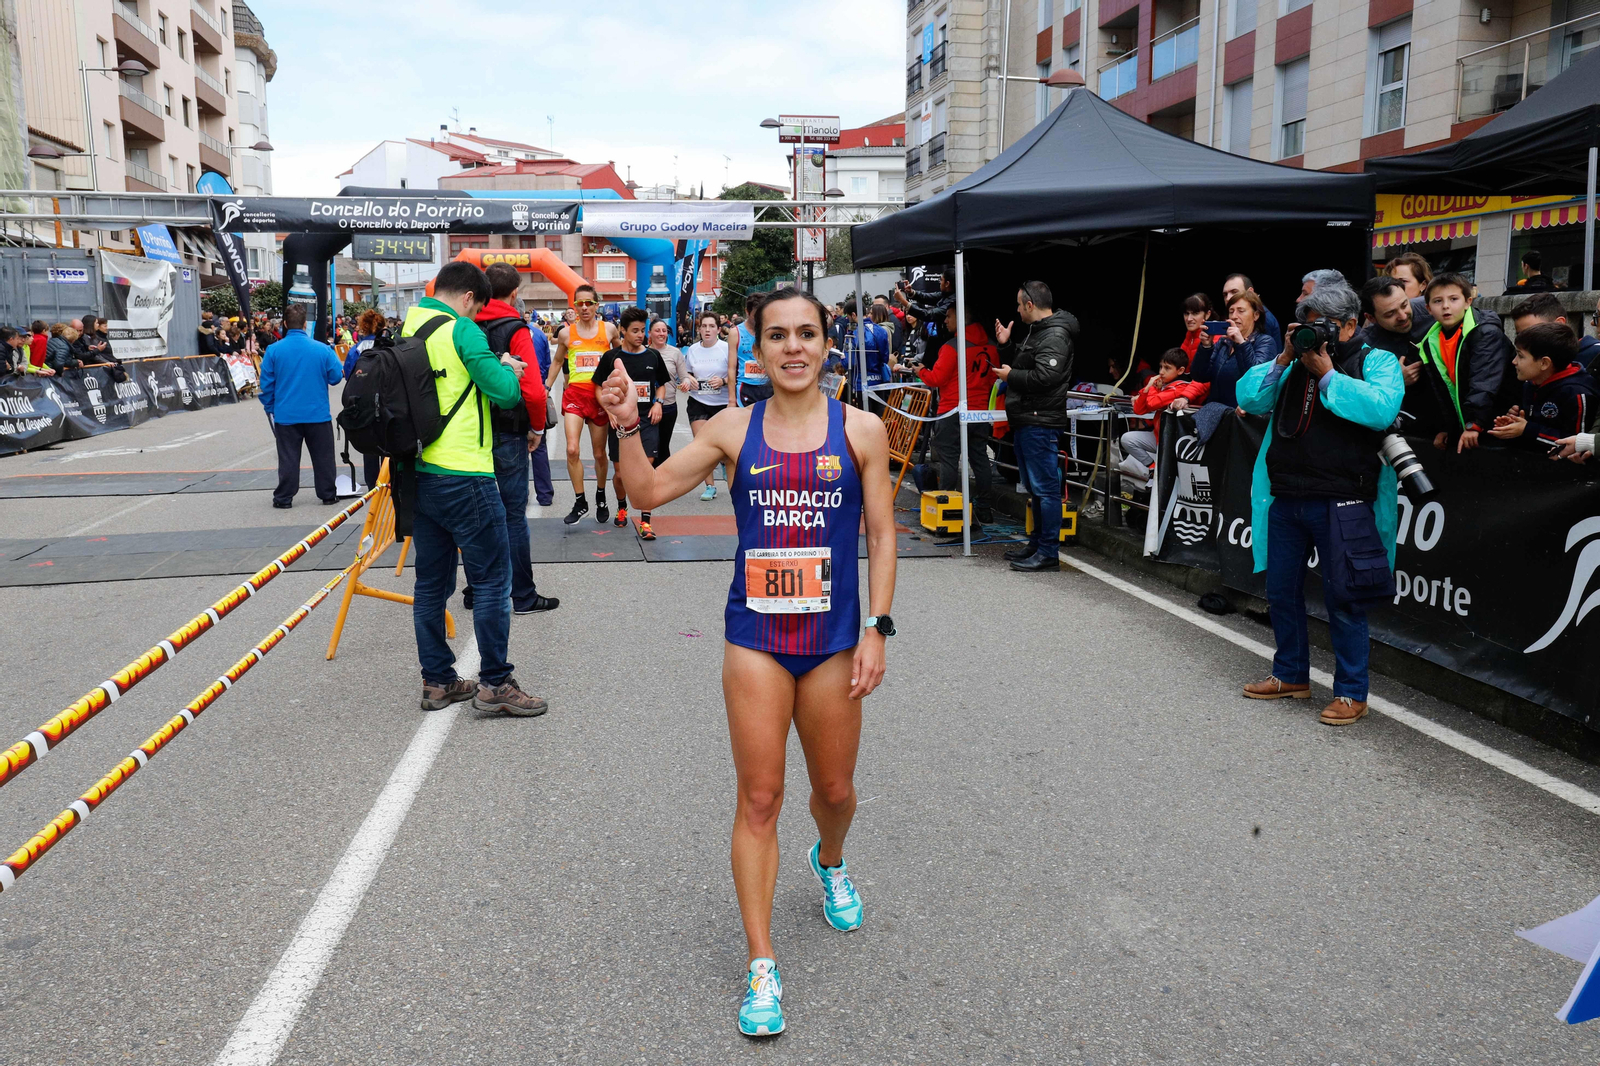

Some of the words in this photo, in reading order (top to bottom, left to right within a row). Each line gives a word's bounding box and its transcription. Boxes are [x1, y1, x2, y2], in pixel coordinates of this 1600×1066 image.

[310, 200, 383, 217] Concello
[388, 201, 410, 217] do
[415, 202, 485, 217] Porriño
[531, 211, 554, 220] Concello
[556, 211, 569, 220] do
[339, 219, 348, 229] O
[350, 219, 392, 229] Concello
[395, 219, 408, 229] do
[411, 219, 450, 230] Deporte
[531, 217, 571, 231] Porriño
[620, 221, 657, 233] Grupo
[660, 221, 699, 233] Godoy
[702, 221, 748, 231] Maceira
[482, 253, 531, 266] GADIS
[582, 357, 595, 367] 123
[748, 487, 843, 508] FUNDACIÓ
[763, 510, 826, 531] BARÇA
[765, 568, 804, 597] 801
